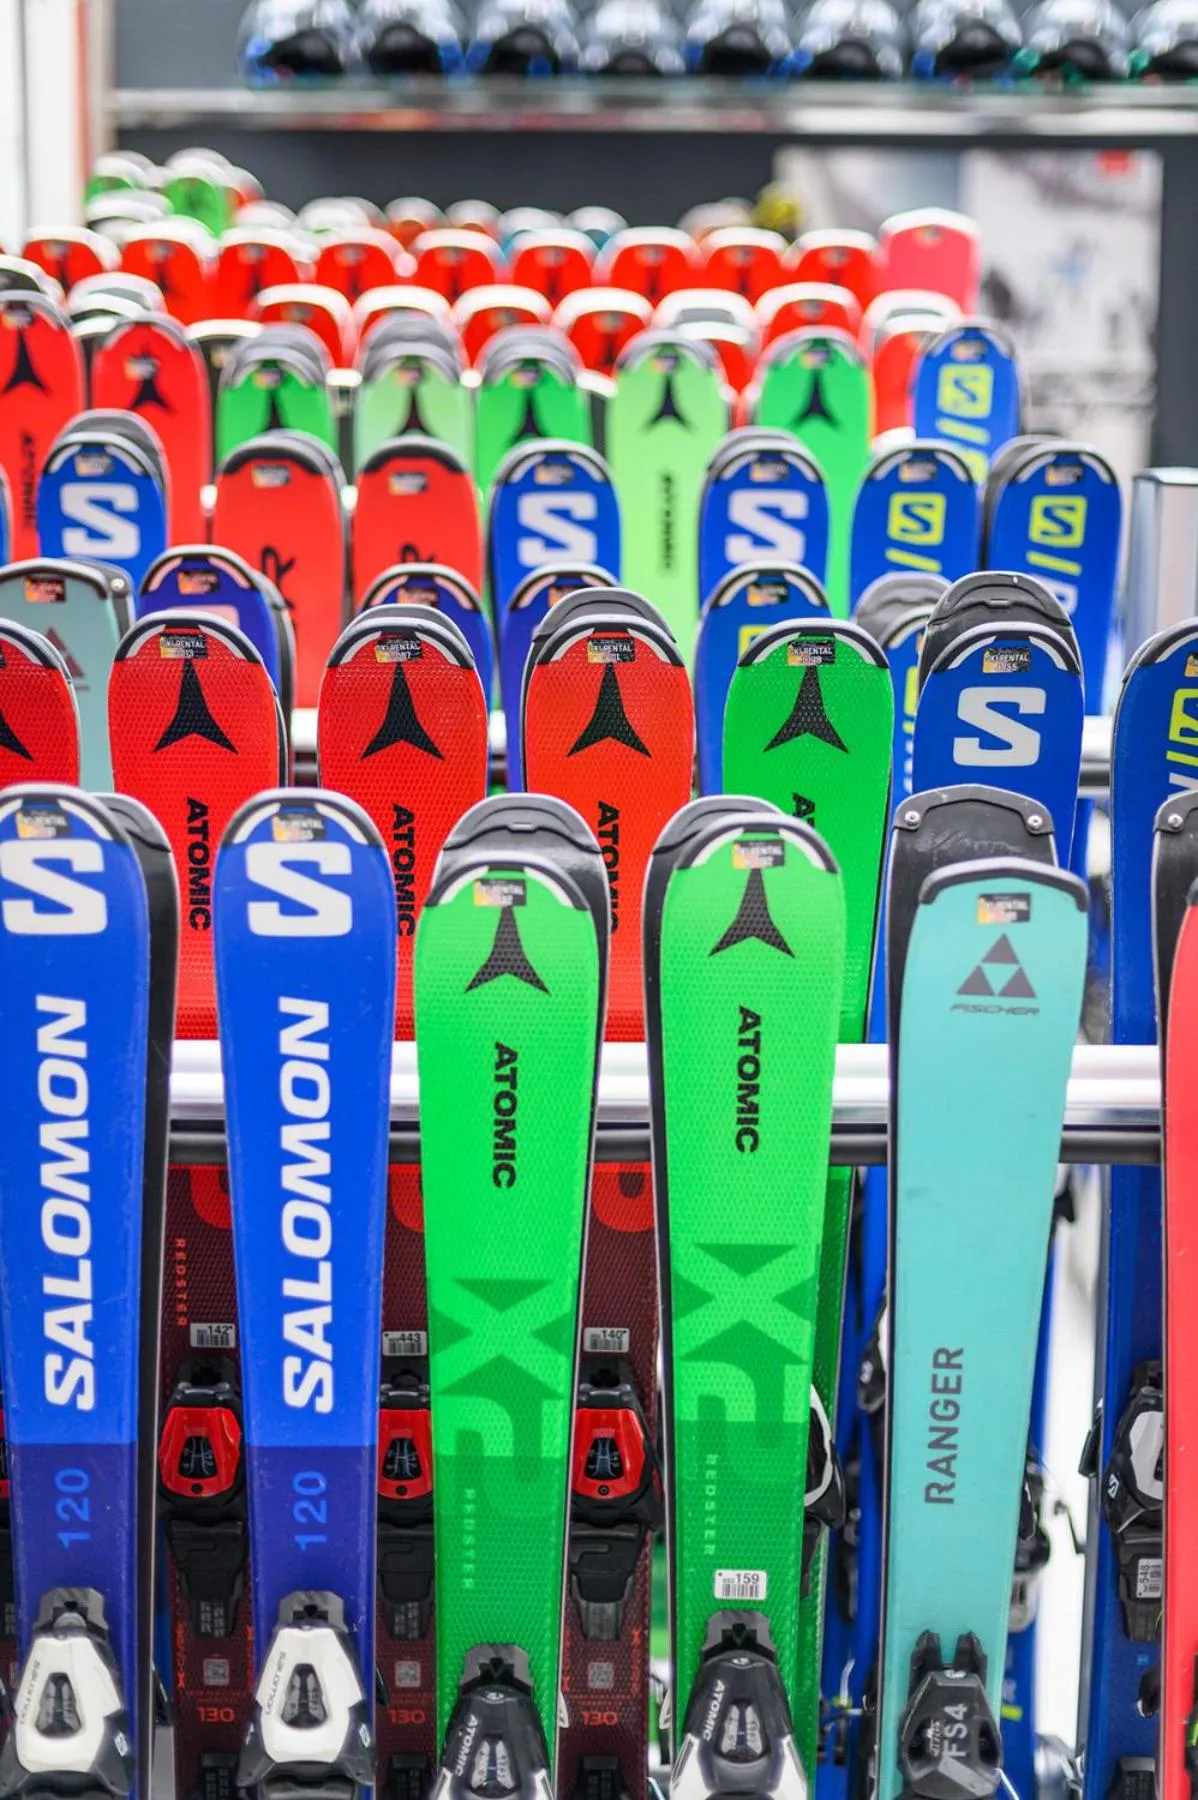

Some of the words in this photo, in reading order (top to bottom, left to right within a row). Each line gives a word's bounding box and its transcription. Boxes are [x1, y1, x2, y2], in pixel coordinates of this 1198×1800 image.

[953, 686, 1046, 767] S
[0, 840, 107, 935] S
[187, 797, 212, 931] ATOMIC
[246, 842, 352, 937] S
[392, 803, 415, 937] ATOMIC
[950, 1003, 1041, 1016] FISCHER
[492, 1041, 518, 1189] ATOMIC
[735, 1006, 761, 1154] ATOMIC
[36, 995, 95, 1412] SALOMON
[279, 996, 333, 1414] SALOMON
[176, 1237, 188, 1326] REDSTER
[924, 1347, 964, 1505] RANGER
[54, 1467, 91, 1550] 120
[292, 1469, 328, 1552] 120
[704, 1454, 718, 1556] REDSTER
[735, 1573, 760, 1584] 159
[196, 1706, 234, 1722] 130
[388, 1709, 426, 1724] 130
[455, 1714, 478, 1777] ATOMIC
[581, 1710, 618, 1725] 130
[703, 1679, 725, 1741] ATOMIC
[943, 1702, 968, 1758] FS4
